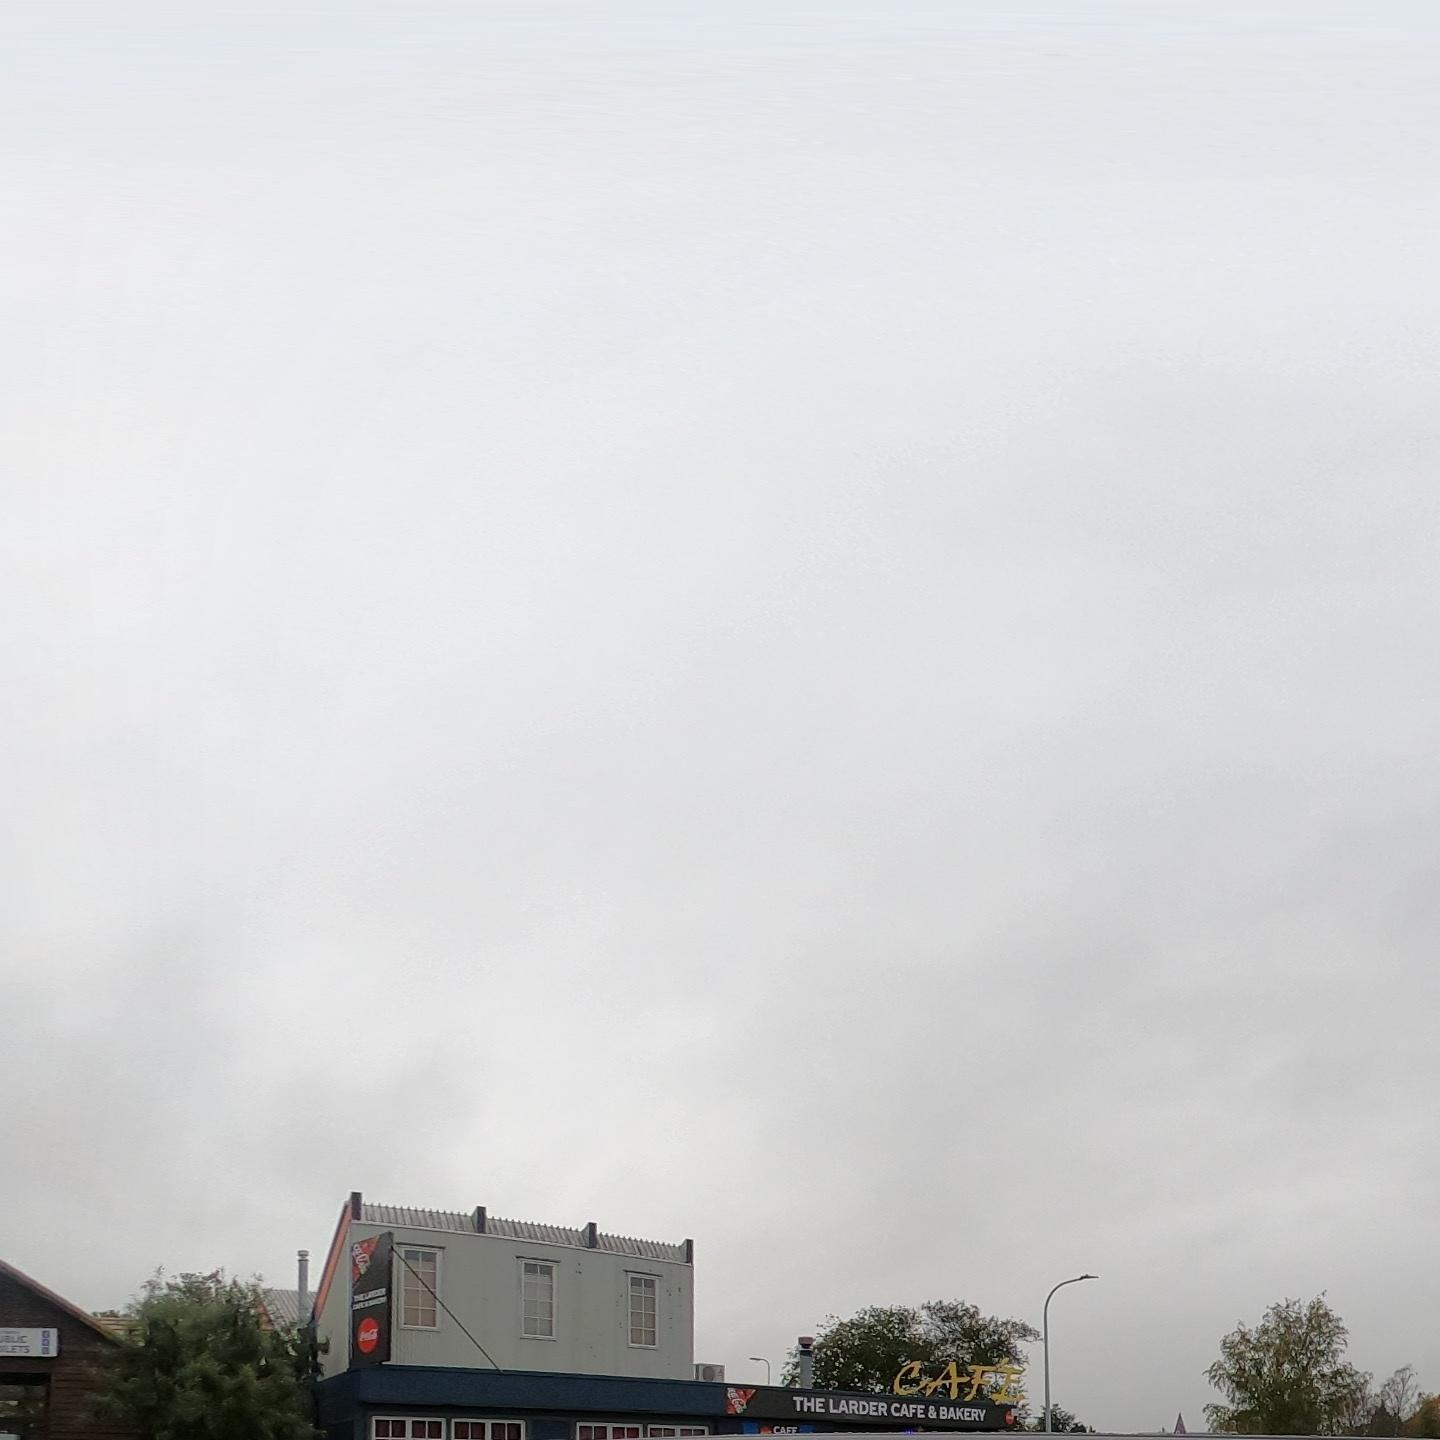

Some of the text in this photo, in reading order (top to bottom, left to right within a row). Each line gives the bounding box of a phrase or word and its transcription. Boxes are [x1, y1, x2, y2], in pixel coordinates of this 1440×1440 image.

[792, 1396, 987, 1422] THE LARDER CAFE & BAKERY
